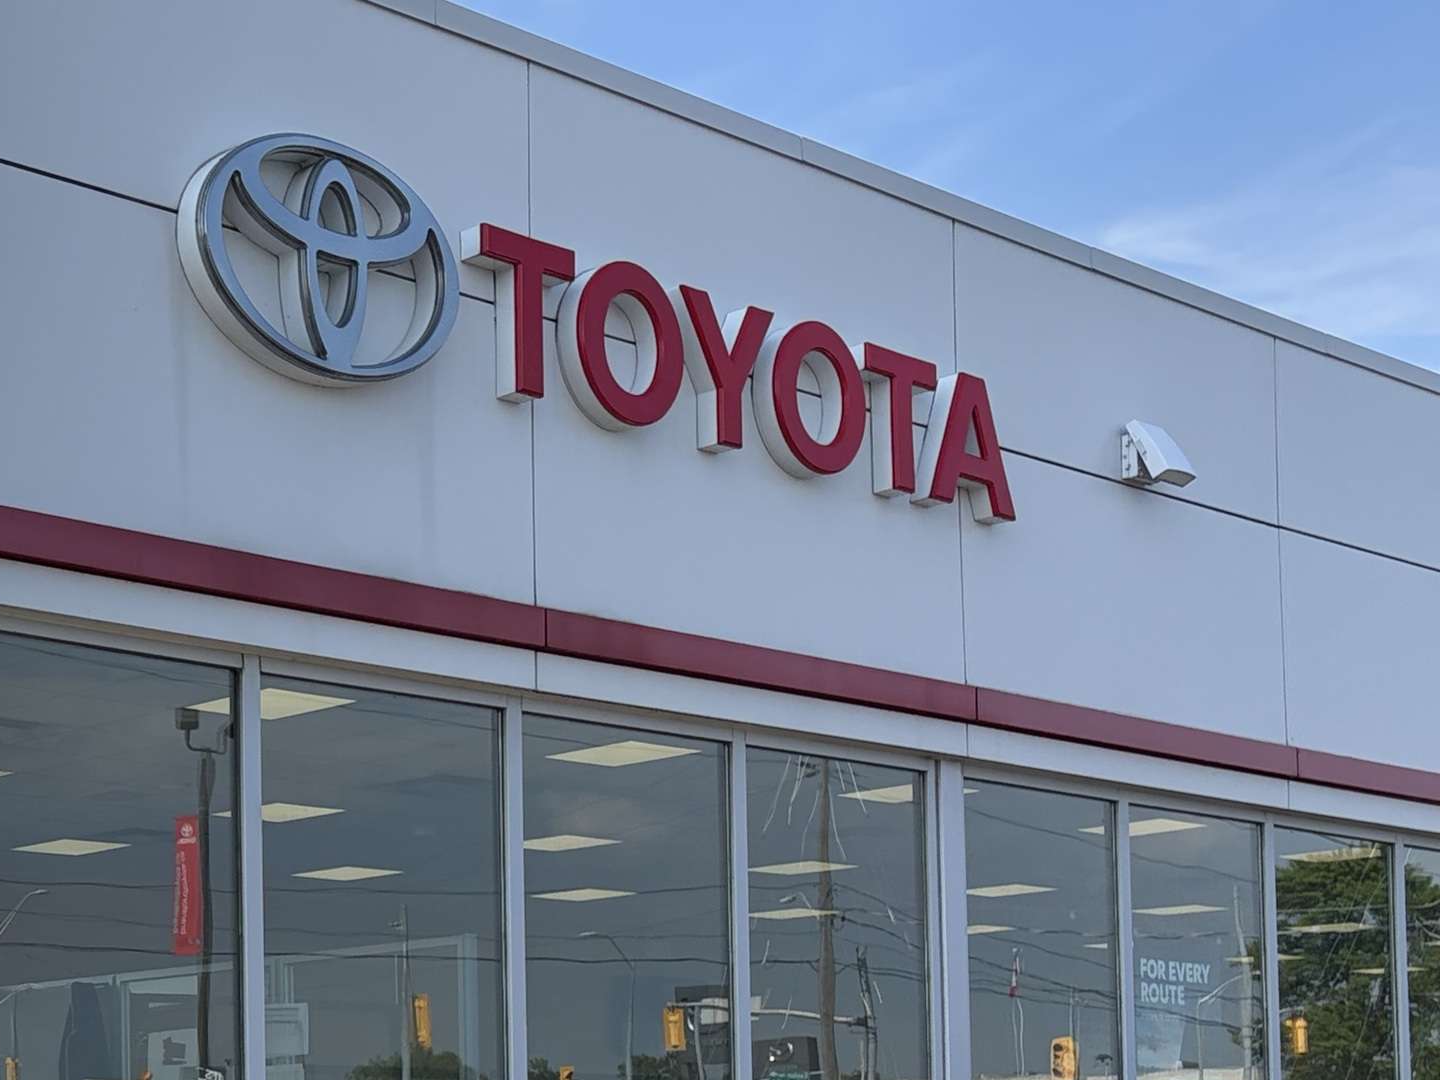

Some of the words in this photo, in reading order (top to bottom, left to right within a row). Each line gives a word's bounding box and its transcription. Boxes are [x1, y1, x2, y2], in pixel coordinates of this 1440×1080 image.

[461, 222, 1017, 526] TOYOTA
[1140, 958, 1166, 980] FOR
[1168, 960, 1210, 984] EVERY
[1140, 982, 1185, 1005] ROUTE
